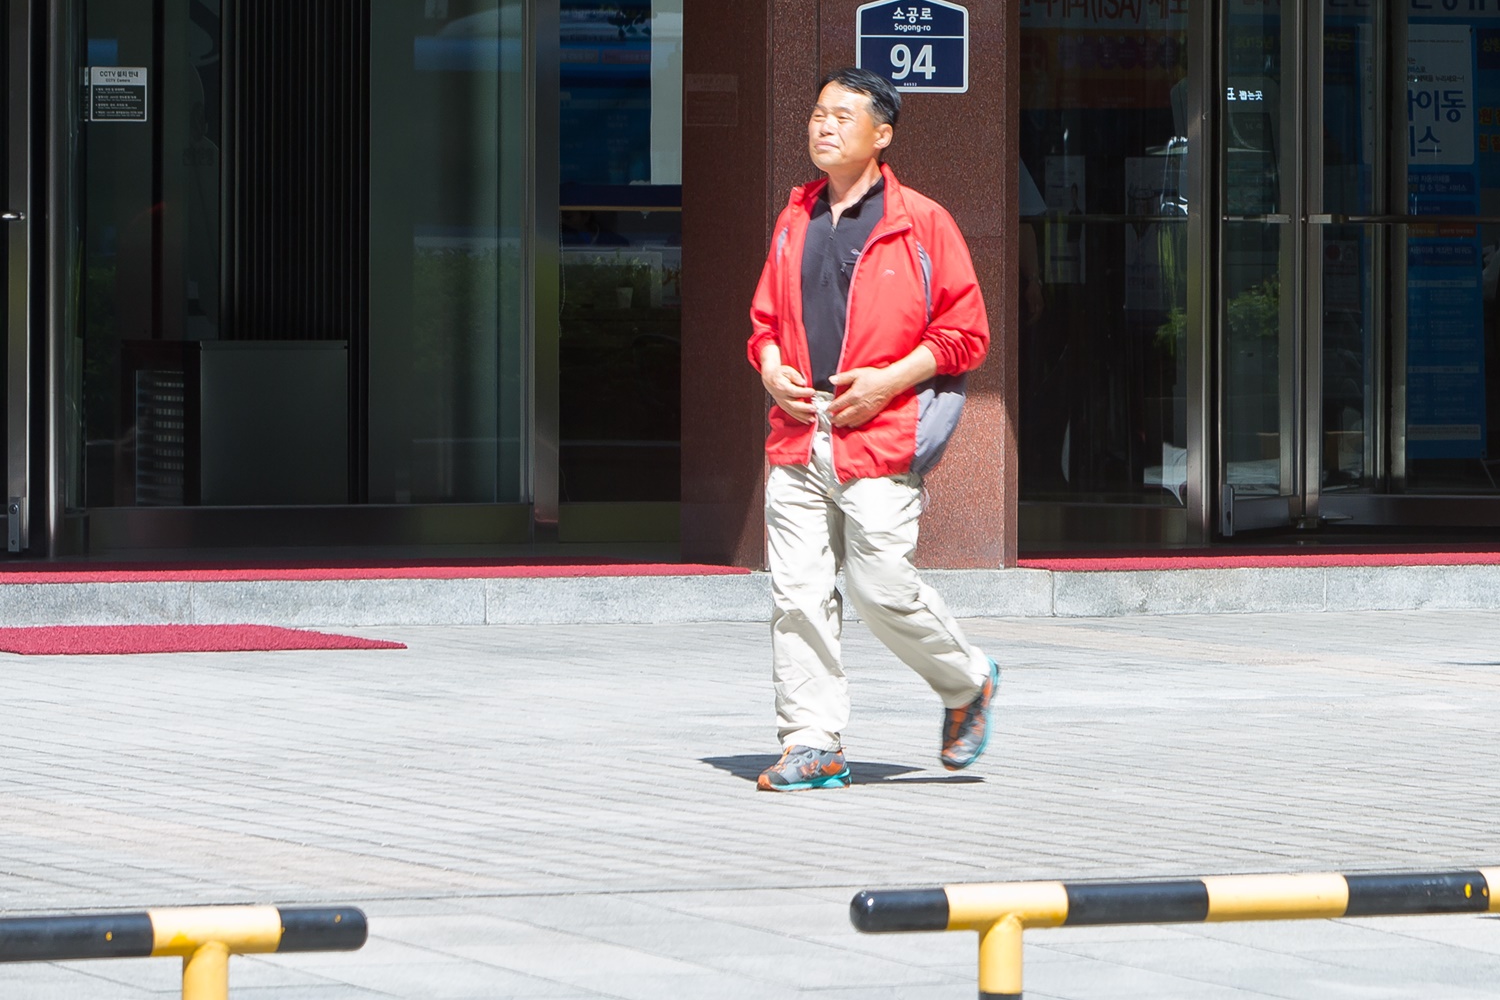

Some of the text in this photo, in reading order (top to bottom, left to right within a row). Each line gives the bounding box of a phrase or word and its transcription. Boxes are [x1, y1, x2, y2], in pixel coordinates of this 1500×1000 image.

[892, 7, 933, 24] 소공로
[894, 22, 931, 32] Sogong-ro
[890, 44, 936, 80] 94
